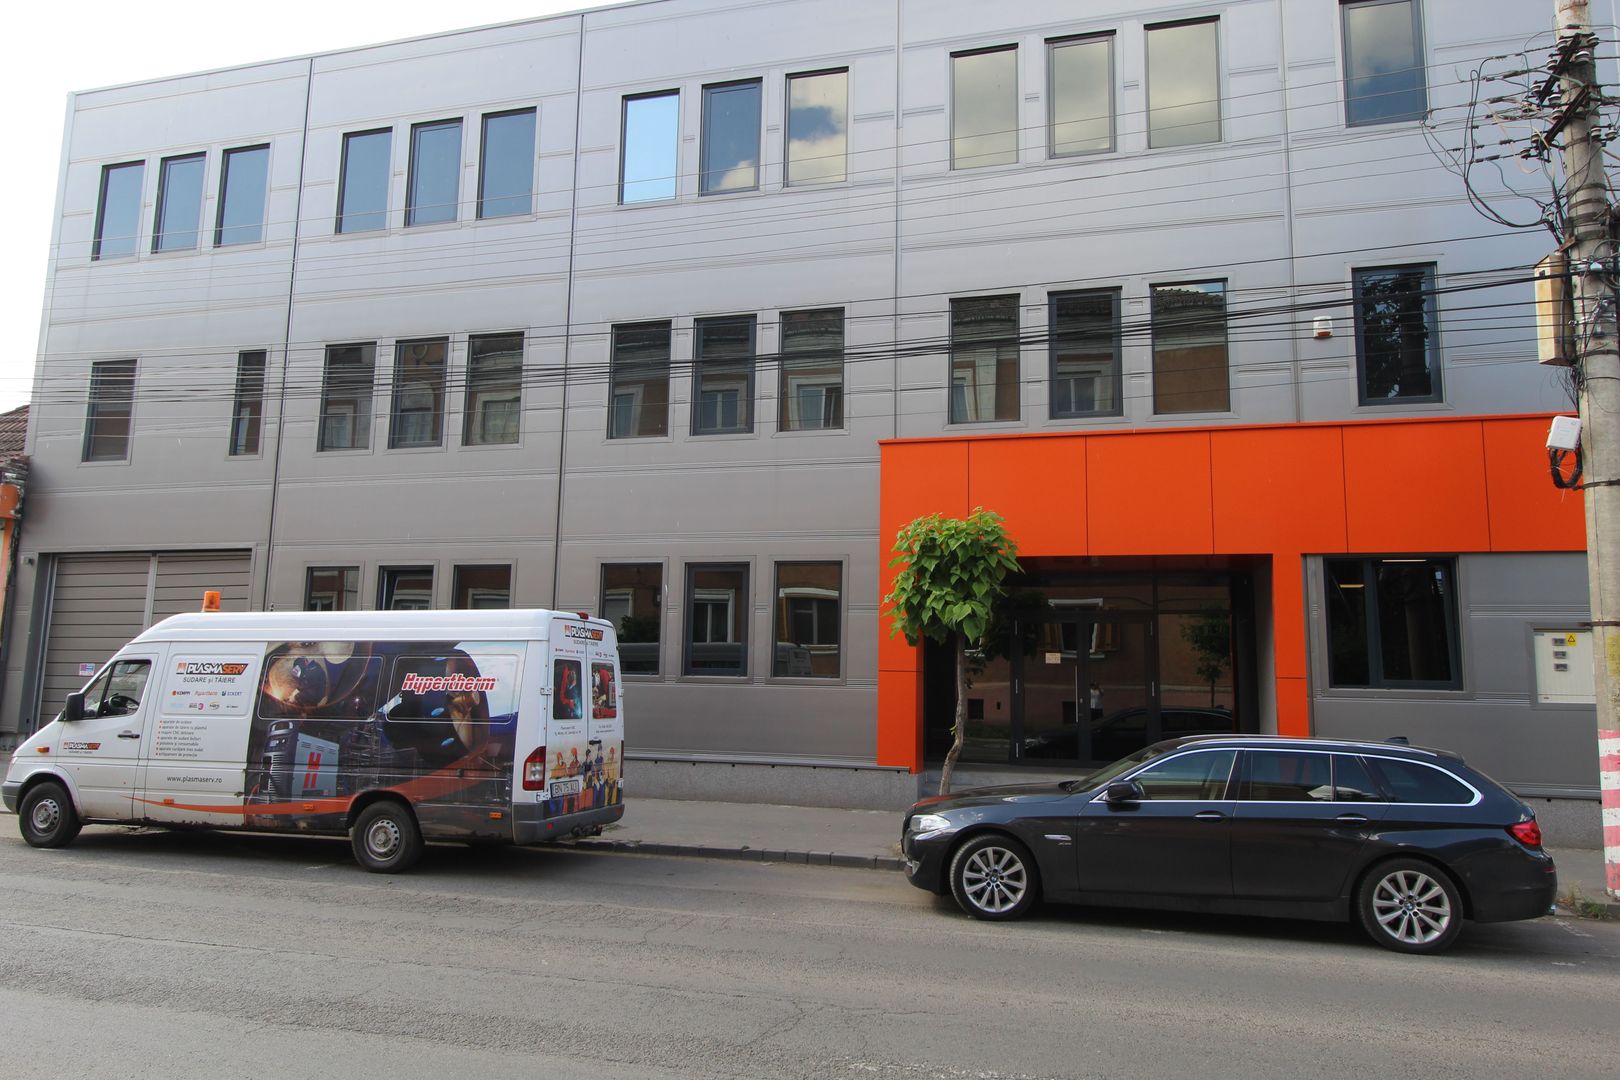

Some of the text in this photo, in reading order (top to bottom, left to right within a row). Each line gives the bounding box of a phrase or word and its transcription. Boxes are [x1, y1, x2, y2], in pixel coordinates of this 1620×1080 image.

[186, 663, 248, 675] PLASMASERV
[402, 673, 496, 694] Hypertherm
[167, 775, 223, 784] www.plasmaserv.ro
